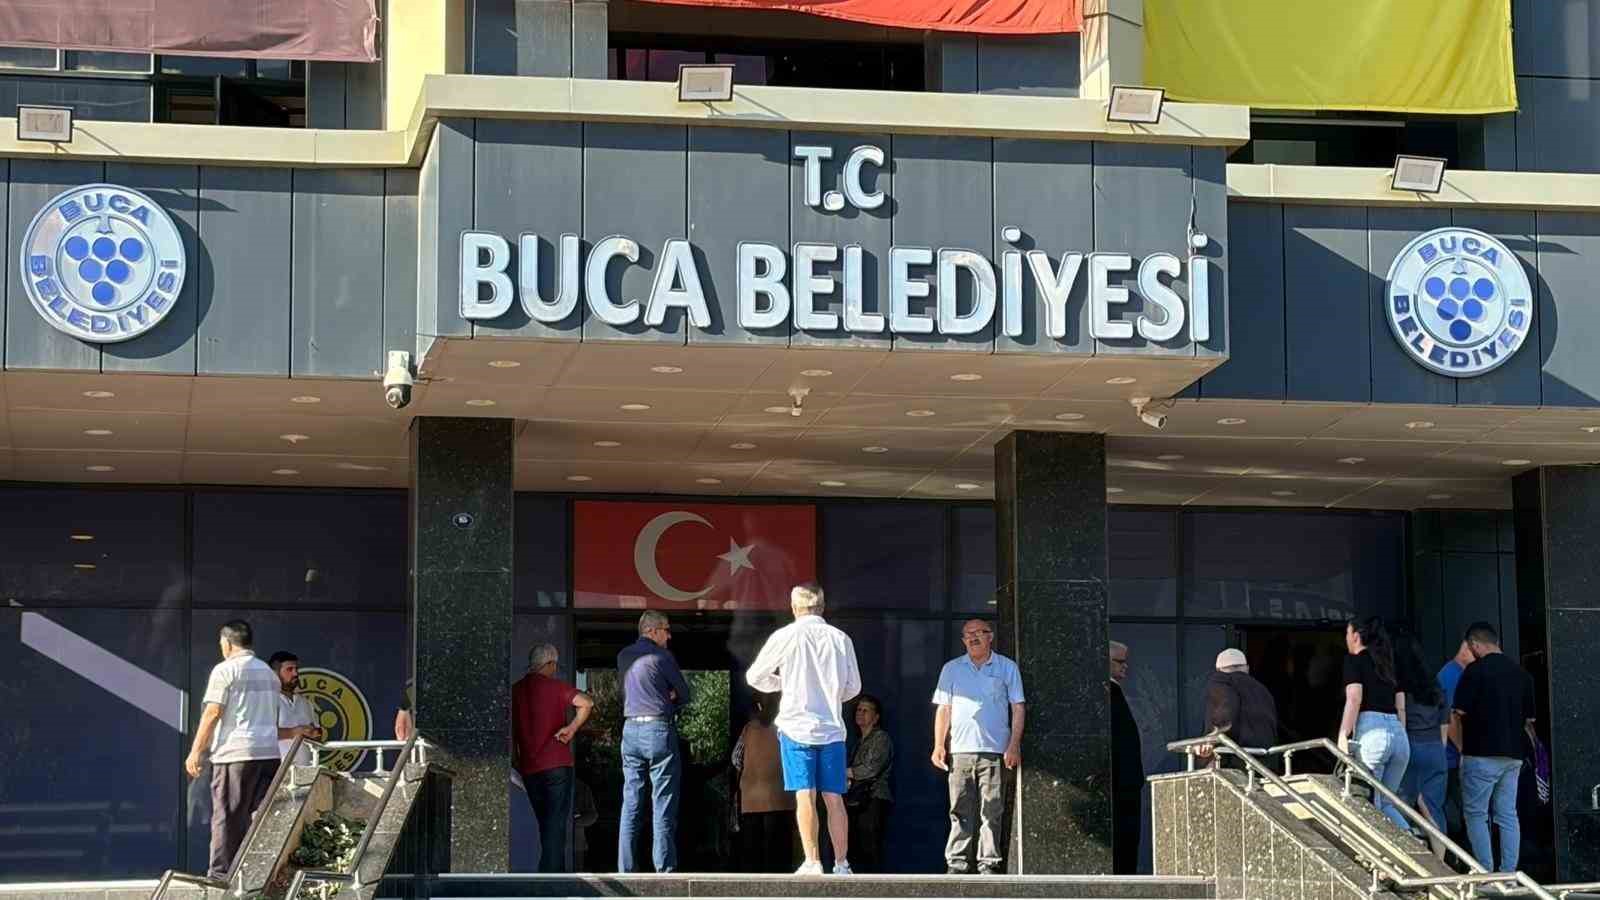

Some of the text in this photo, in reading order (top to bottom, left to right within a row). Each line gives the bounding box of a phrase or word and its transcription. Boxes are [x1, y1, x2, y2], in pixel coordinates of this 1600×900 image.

[794, 144, 885, 211] T.C
[59, 193, 151, 226] BUCA
[1417, 236, 1499, 266] BUCA
[459, 225, 1210, 342] BUCA BELEDİYESİ
[298, 679, 343, 699] UCA
